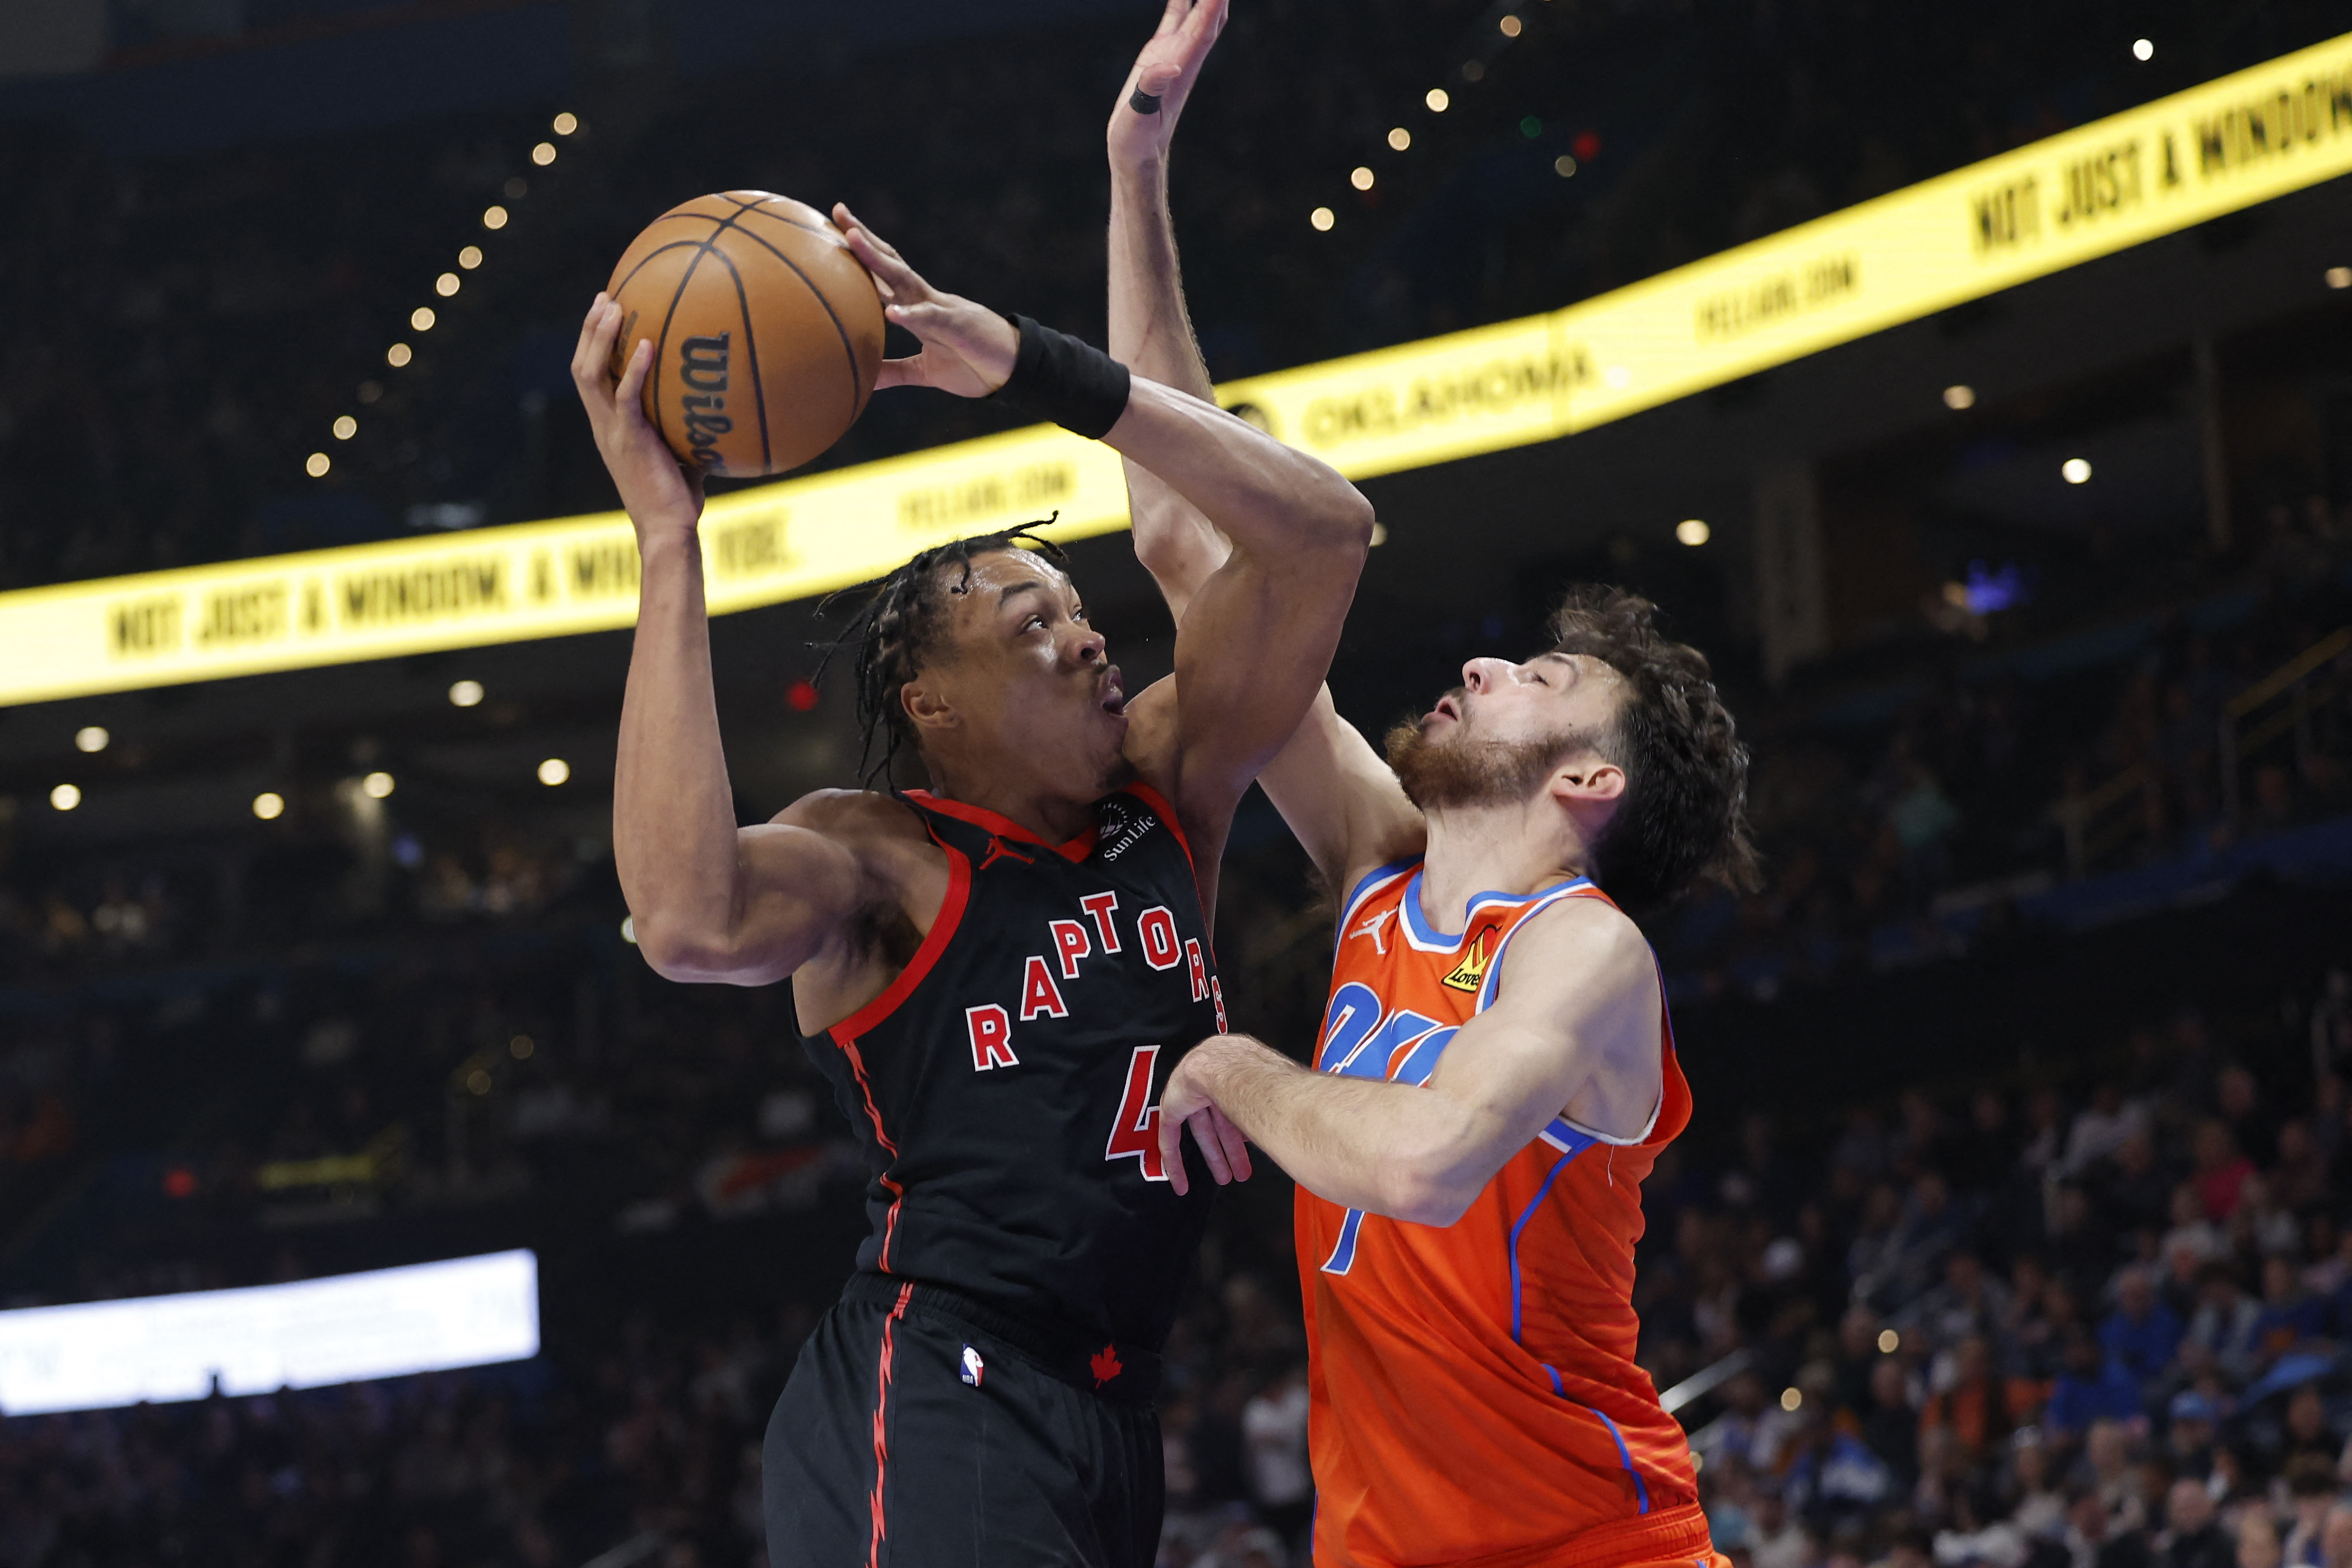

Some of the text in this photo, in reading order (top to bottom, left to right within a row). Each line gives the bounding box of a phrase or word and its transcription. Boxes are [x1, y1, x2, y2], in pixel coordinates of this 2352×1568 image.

[1972, 173, 2039, 252] NOT
[2057, 138, 2144, 227] JUST
[2160, 128, 2182, 187] A
[1308, 346, 1594, 441] OKLAHOMA
[113, 597, 178, 654] NOT
[197, 583, 287, 643] JUST
[301, 581, 325, 631] A
[1104, 816, 1156, 862] Sun Life
[965, 890, 1228, 1072] RAPTORS
[1105, 1045, 1169, 1182] 4
[962, 1374, 973, 1384] NBA
